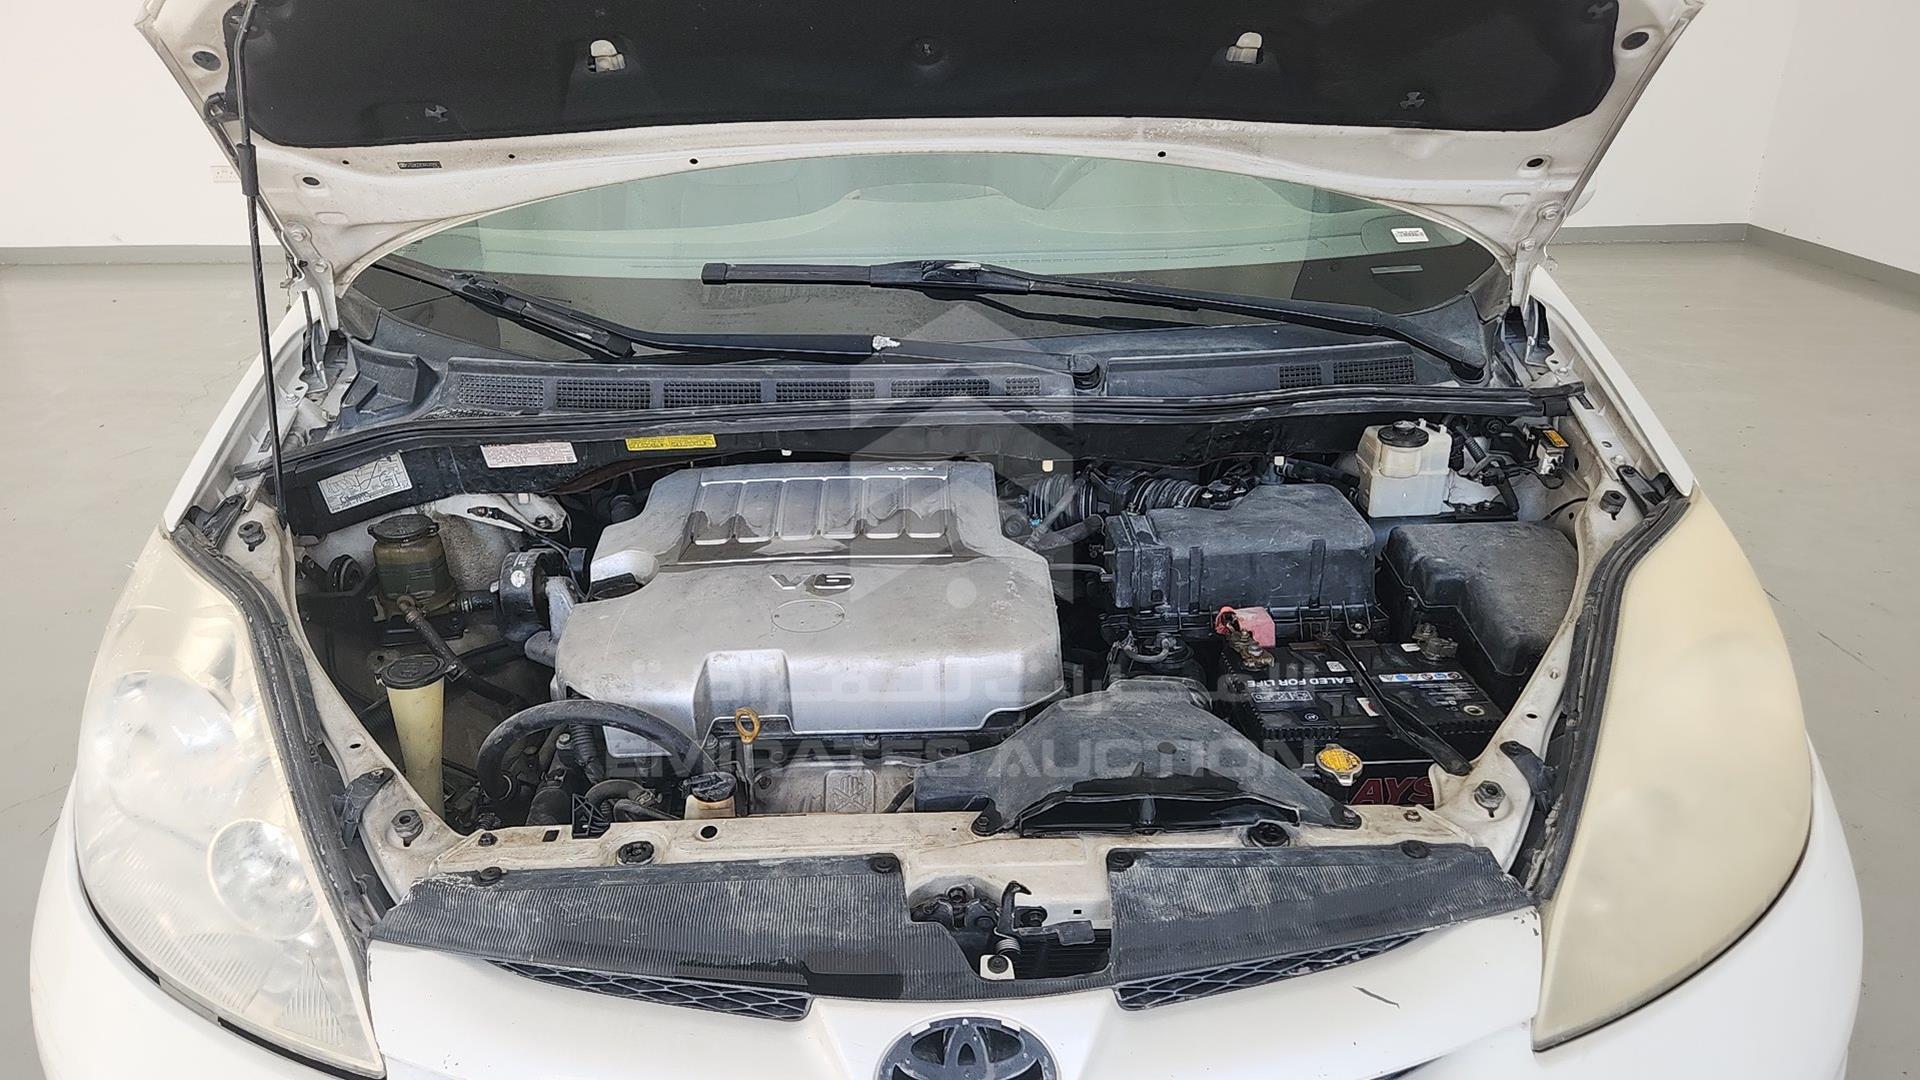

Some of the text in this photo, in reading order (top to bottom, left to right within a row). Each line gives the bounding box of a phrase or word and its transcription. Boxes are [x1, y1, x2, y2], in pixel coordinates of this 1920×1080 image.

[769, 573, 854, 593] V6
[1247, 676, 1354, 688] EALED FOR LIFE
